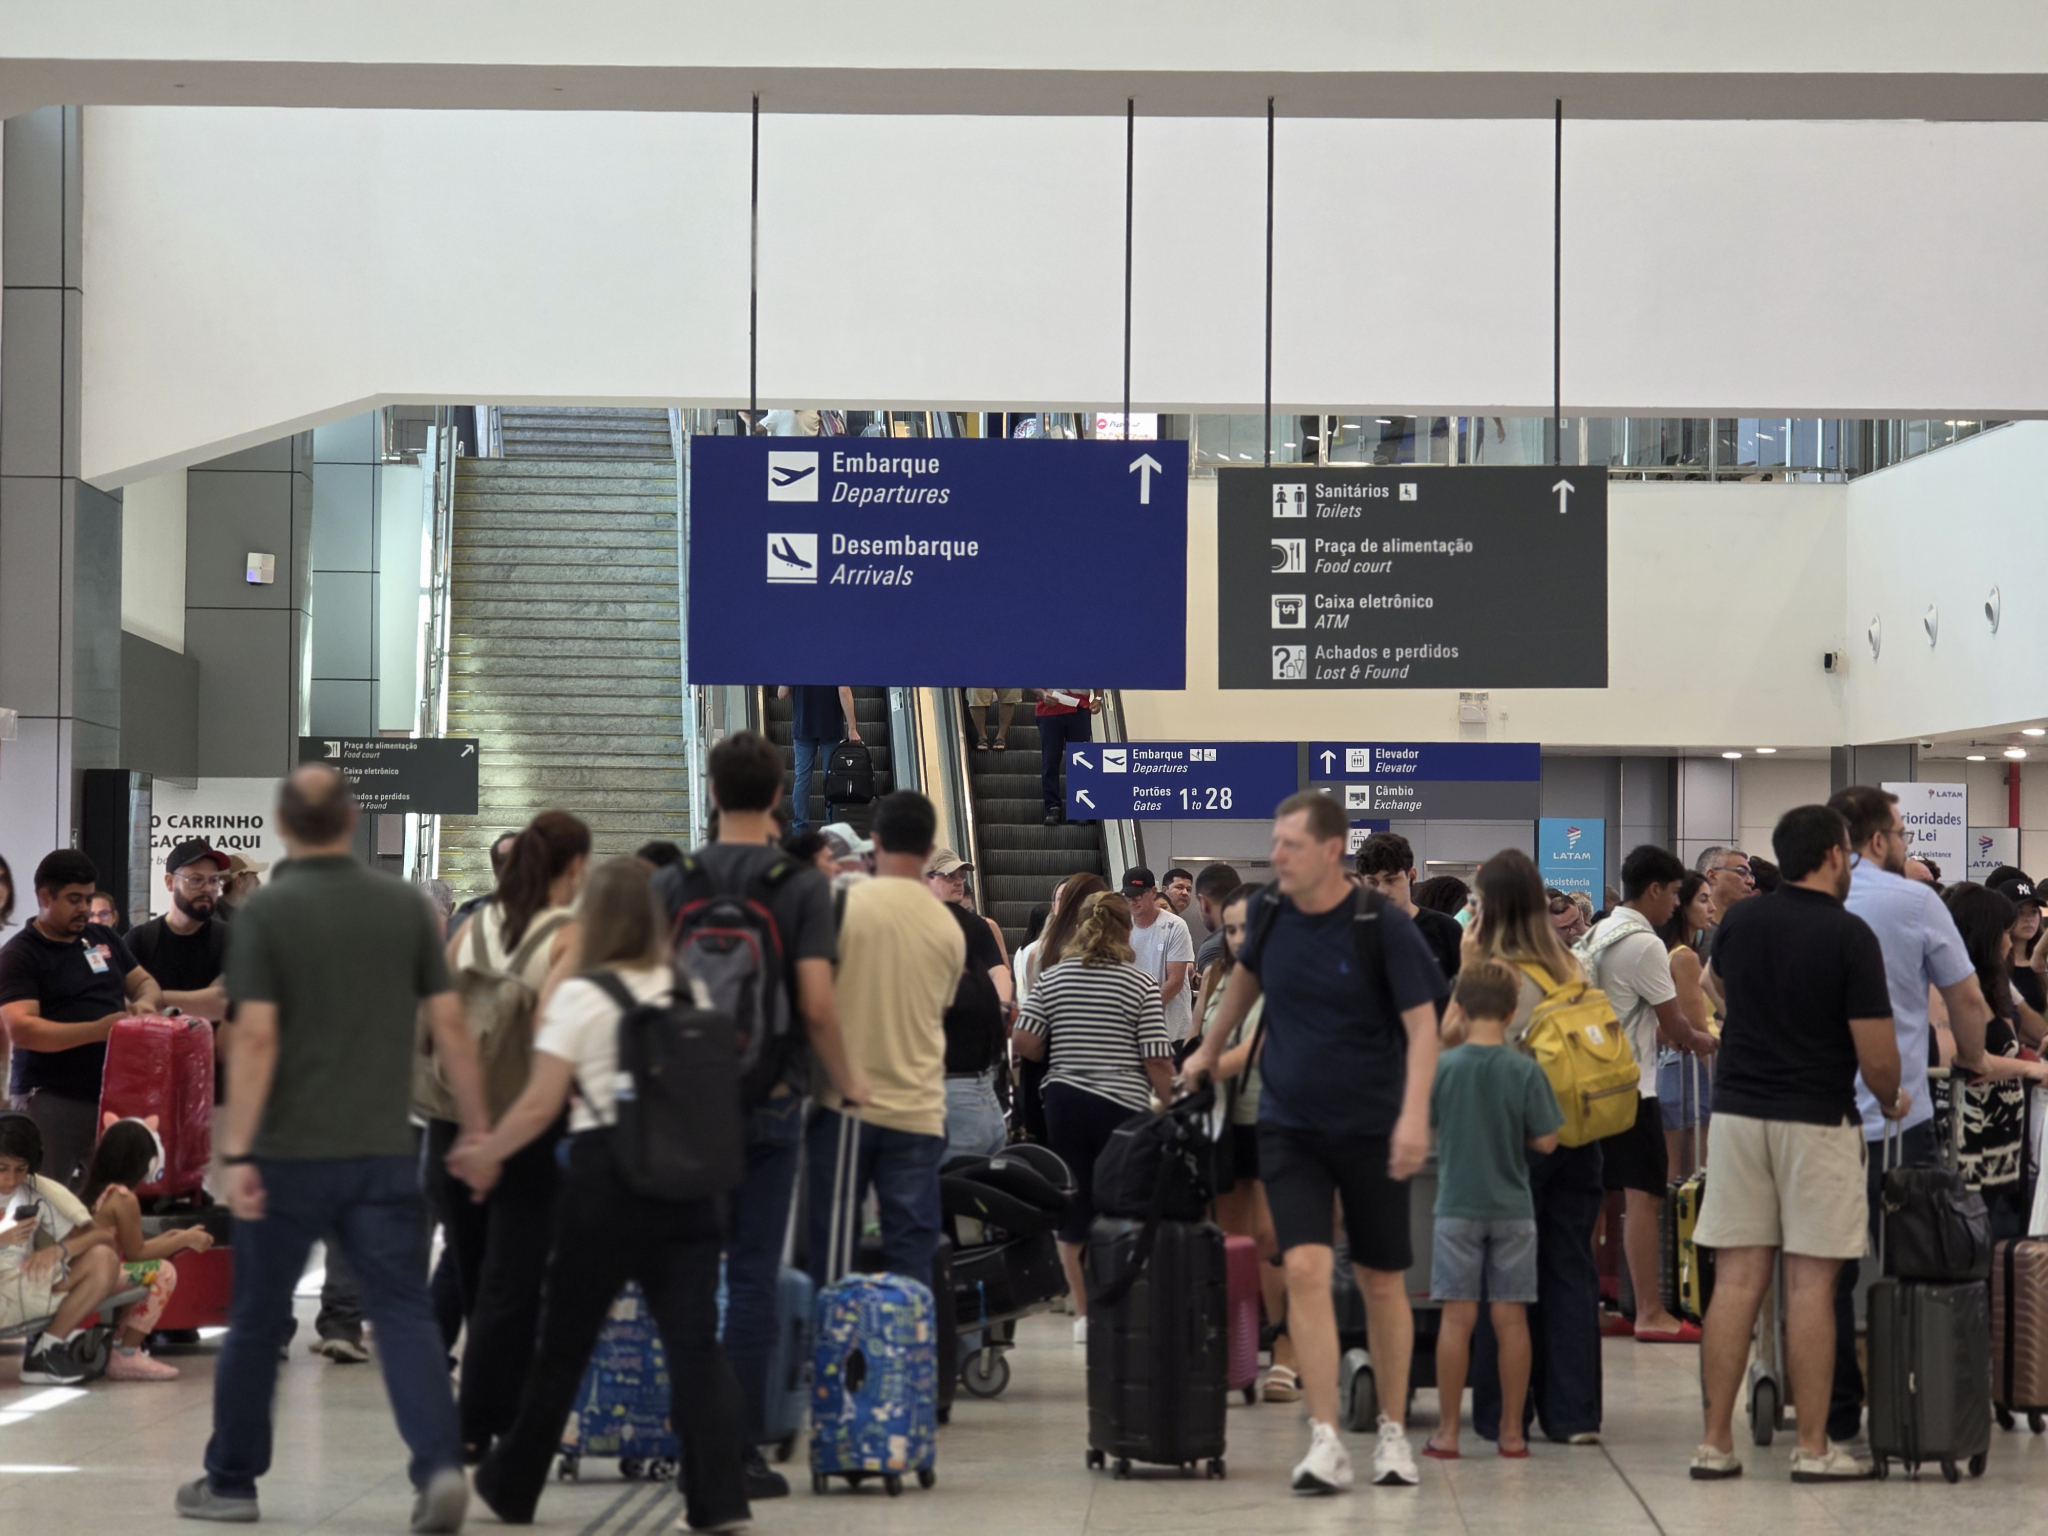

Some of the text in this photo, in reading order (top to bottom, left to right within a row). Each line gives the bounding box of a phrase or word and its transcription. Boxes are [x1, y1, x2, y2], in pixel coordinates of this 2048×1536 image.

[833, 452, 940, 478] Embarque
[832, 482, 950, 507] Departures
[1315, 483, 1390, 499] Sanitários
[1315, 504, 1362, 518] Toilets
[832, 534, 979, 560] Desembarque
[1315, 538, 1473, 557] Praça de alimentação
[1314, 559, 1392, 574] Food court
[830, 564, 914, 586] Arrivals
[1314, 593, 1434, 609] Caixa eletrônico
[1314, 614, 1350, 629] ATM
[1315, 644, 1459, 662] Achados e perdidos
[1315, 664, 1410, 680] Lost & Found
[344, 741, 418, 751] Praça de alimentação
[343, 751, 381, 759] Food court
[1132, 748, 1184, 762] Embarque
[1375, 748, 1419, 759] Elevador
[343, 766, 399, 775] Caixa eletrônico
[1132, 762, 1189, 775] Departures
[1375, 762, 1417, 773] Elevator
[380, 792, 410, 802] perdidos
[1375, 785, 1414, 796] Câmbio
[1133, 786, 1172, 797] Portões
[1179, 788, 1188, 811] 1
[1205, 787, 1233, 810] 28
[1133, 800, 1202, 811] Gates to
[1373, 799, 1422, 812] Exchange
[365, 802, 388, 810] Found
[167, 815, 264, 829] CARRINHO
[1901, 812, 1961, 826] rioridades
[216, 835, 261, 850] AQUI
[1918, 829, 1937, 842] Lei
[1553, 852, 1591, 860] LATAM
[1544, 877, 1590, 887] Assistência
